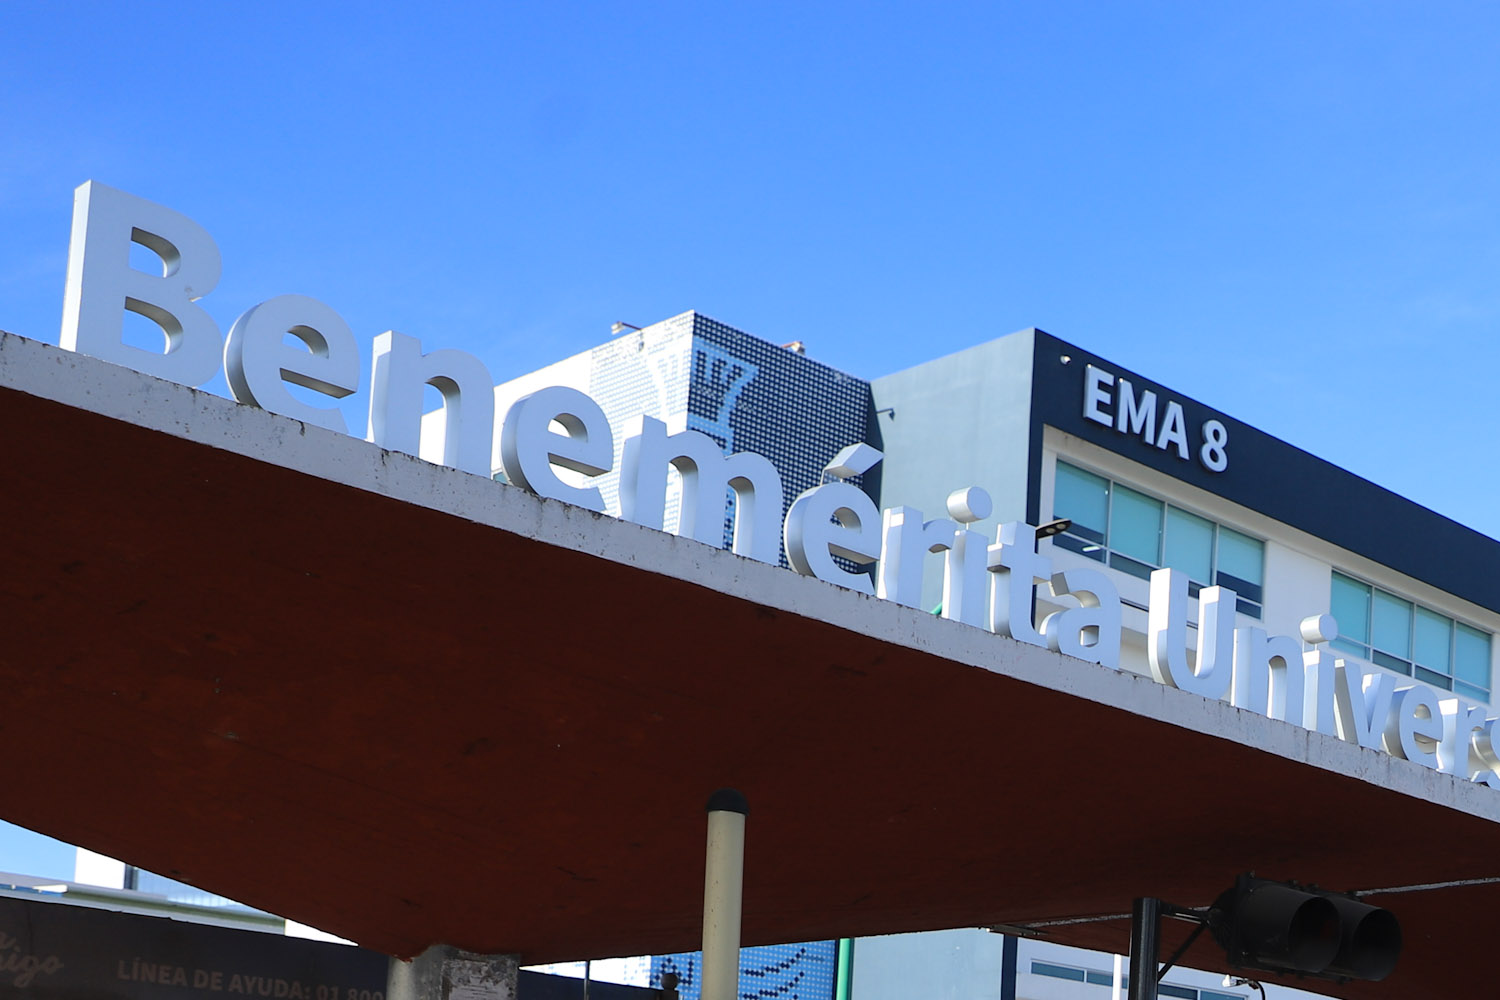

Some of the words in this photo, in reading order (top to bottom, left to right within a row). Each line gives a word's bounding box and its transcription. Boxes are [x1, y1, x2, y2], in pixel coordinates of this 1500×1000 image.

[60, 179, 1121, 672] Benemérita
[1083, 362, 1190, 462] EMA
[1201, 419, 1229, 475] 8
[117, 957, 187, 986] LÍNEA
[193, 969, 223, 991] DE
[228, 974, 310, 1000] AYUDA:
